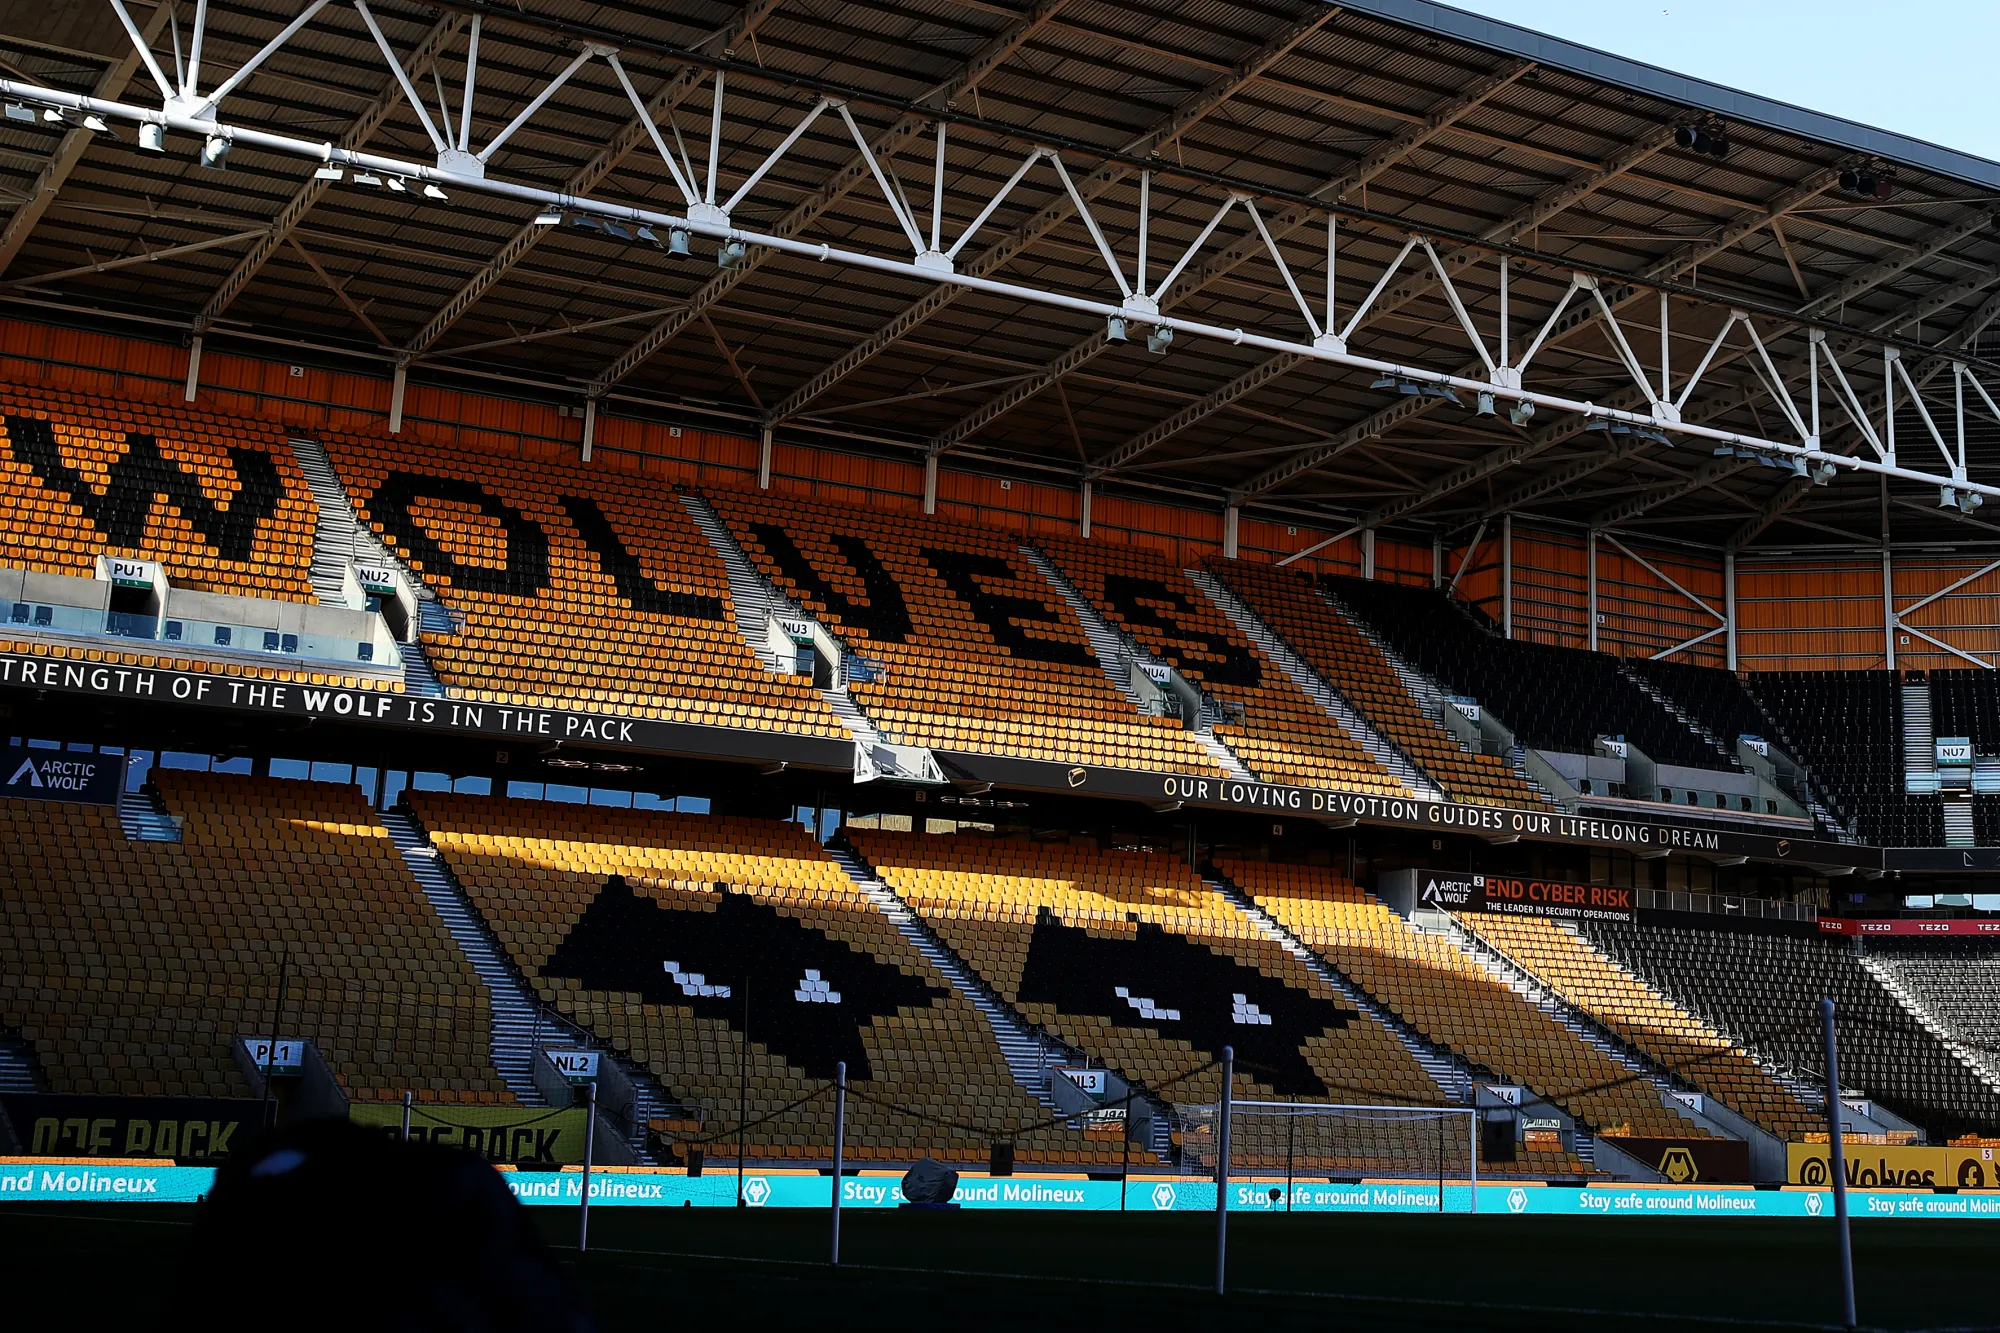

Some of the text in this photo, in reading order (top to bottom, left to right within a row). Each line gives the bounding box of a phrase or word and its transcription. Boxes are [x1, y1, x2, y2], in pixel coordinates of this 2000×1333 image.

[293, 367, 300, 376] 2
[4, 415, 1262, 690] WOLVES
[113, 563, 143, 578] PU1
[360, 569, 390, 583] NU2
[782, 622, 807, 635] NU3
[172, 676, 212, 701] OF
[229, 682, 287, 709] THE
[303, 689, 393, 718] WOLF
[407, 700, 436, 723] IS
[451, 705, 483, 729] IN
[498, 709, 552, 735] THE
[565, 716, 634, 743] PACK
[1942, 748, 1965, 757] NU7
[40, 760, 96, 777] ARCTIC
[47, 775, 89, 791] WOLF
[1163, 778, 1720, 850] OUR LOVING DEVOTION GUIDES OUR LIFELONG DREAM
[1439, 880, 1471, 893] ARCTIC
[1485, 876, 1630, 909] END CYBER RISK
[1444, 892, 1468, 904] WOLF
[1486, 902, 1630, 922] THE LEADER IN SECURITY OPERATIONS
[1820, 921, 1843, 930] TEZO
[1860, 923, 1892, 931] TEZO
[1918, 923, 1949, 931] TEZO
[555, 1056, 589, 1073] NL2
[41, 1171, 158, 1193] Molineux
[566, 1178, 663, 1199] Molineux
[844, 1181, 886, 1205] Stay
[953, 1183, 998, 1202] ound
[1003, 1183, 1085, 1203] Molineux
[1237, 1187, 1272, 1209] Stay
[1314, 1188, 1369, 1206] around
[1373, 1188, 1441, 1207] Molineux
[1579, 1192, 1757, 1212] Stay safe around Molineux
[1868, 1197, 1896, 1215] Stay
[1899, 1197, 1924, 1212] safe
[1926, 1198, 1966, 1213] around
